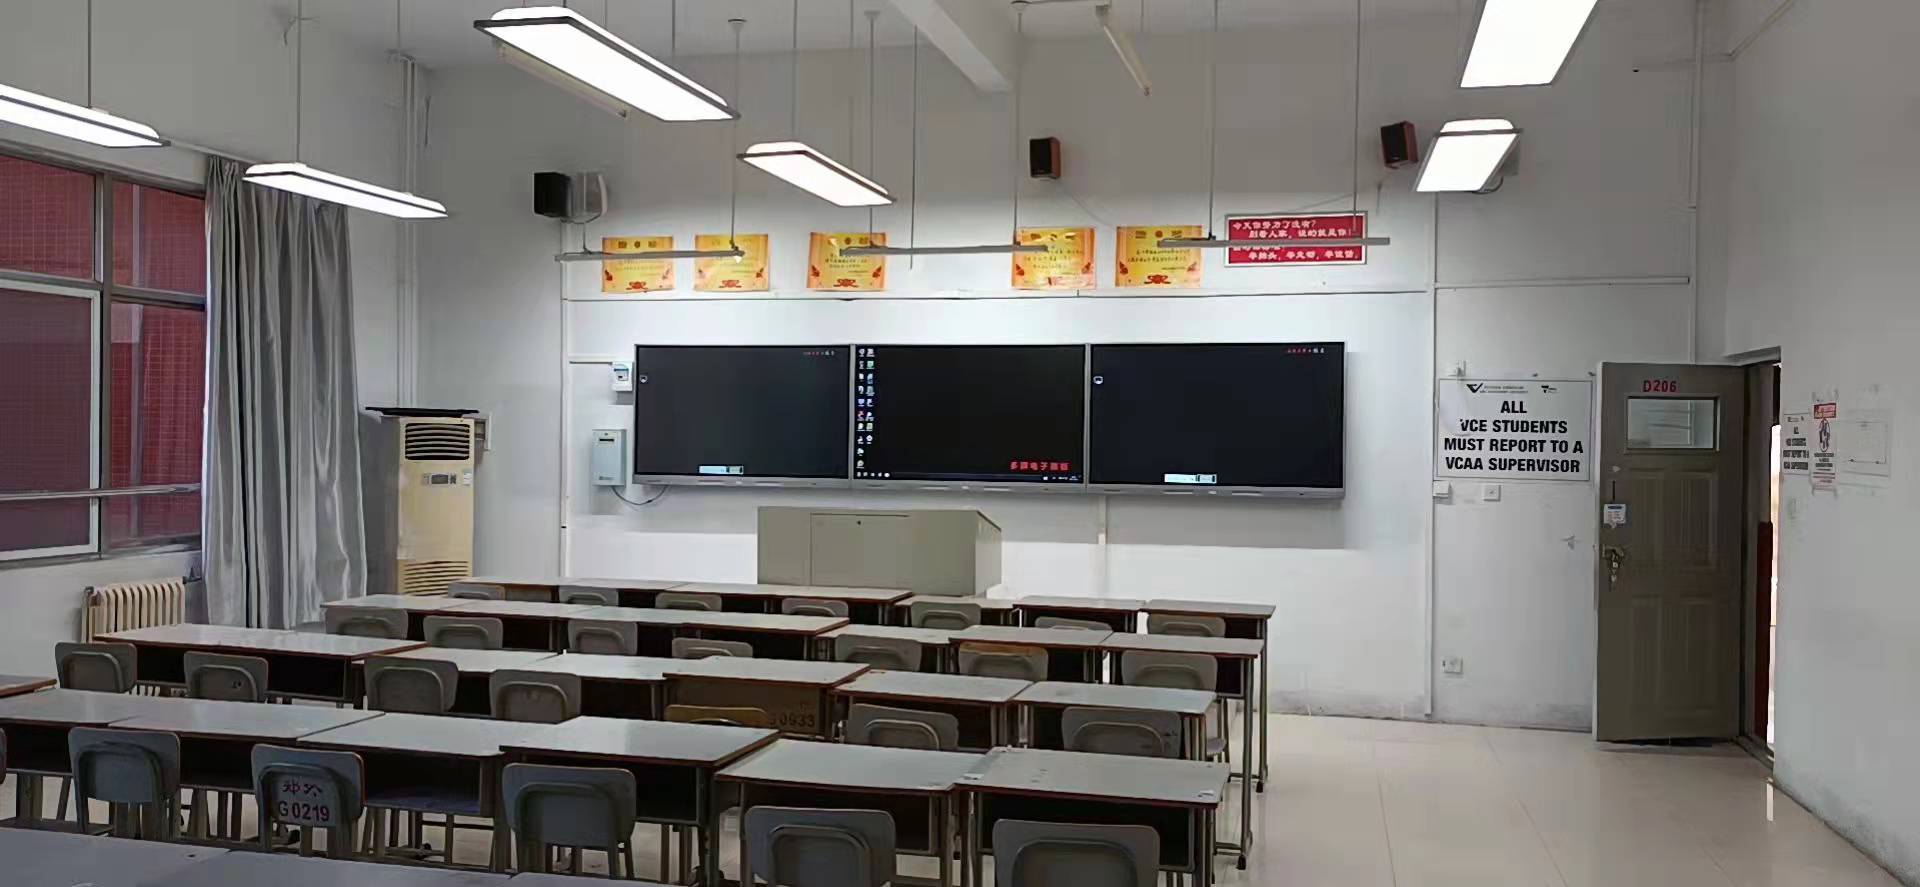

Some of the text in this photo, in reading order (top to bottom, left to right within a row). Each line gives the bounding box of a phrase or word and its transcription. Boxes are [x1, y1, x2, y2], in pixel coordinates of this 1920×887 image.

[1643, 379, 1677, 393] D206
[1501, 401, 1527, 414] ALL
[1461, 419, 1568, 433] VCE STUDENTS
[1444, 438, 1584, 454] MUST REPORT TO A
[1446, 457, 1580, 473] VCAA SUPERVISOR
[278, 801, 330, 822] G0219
